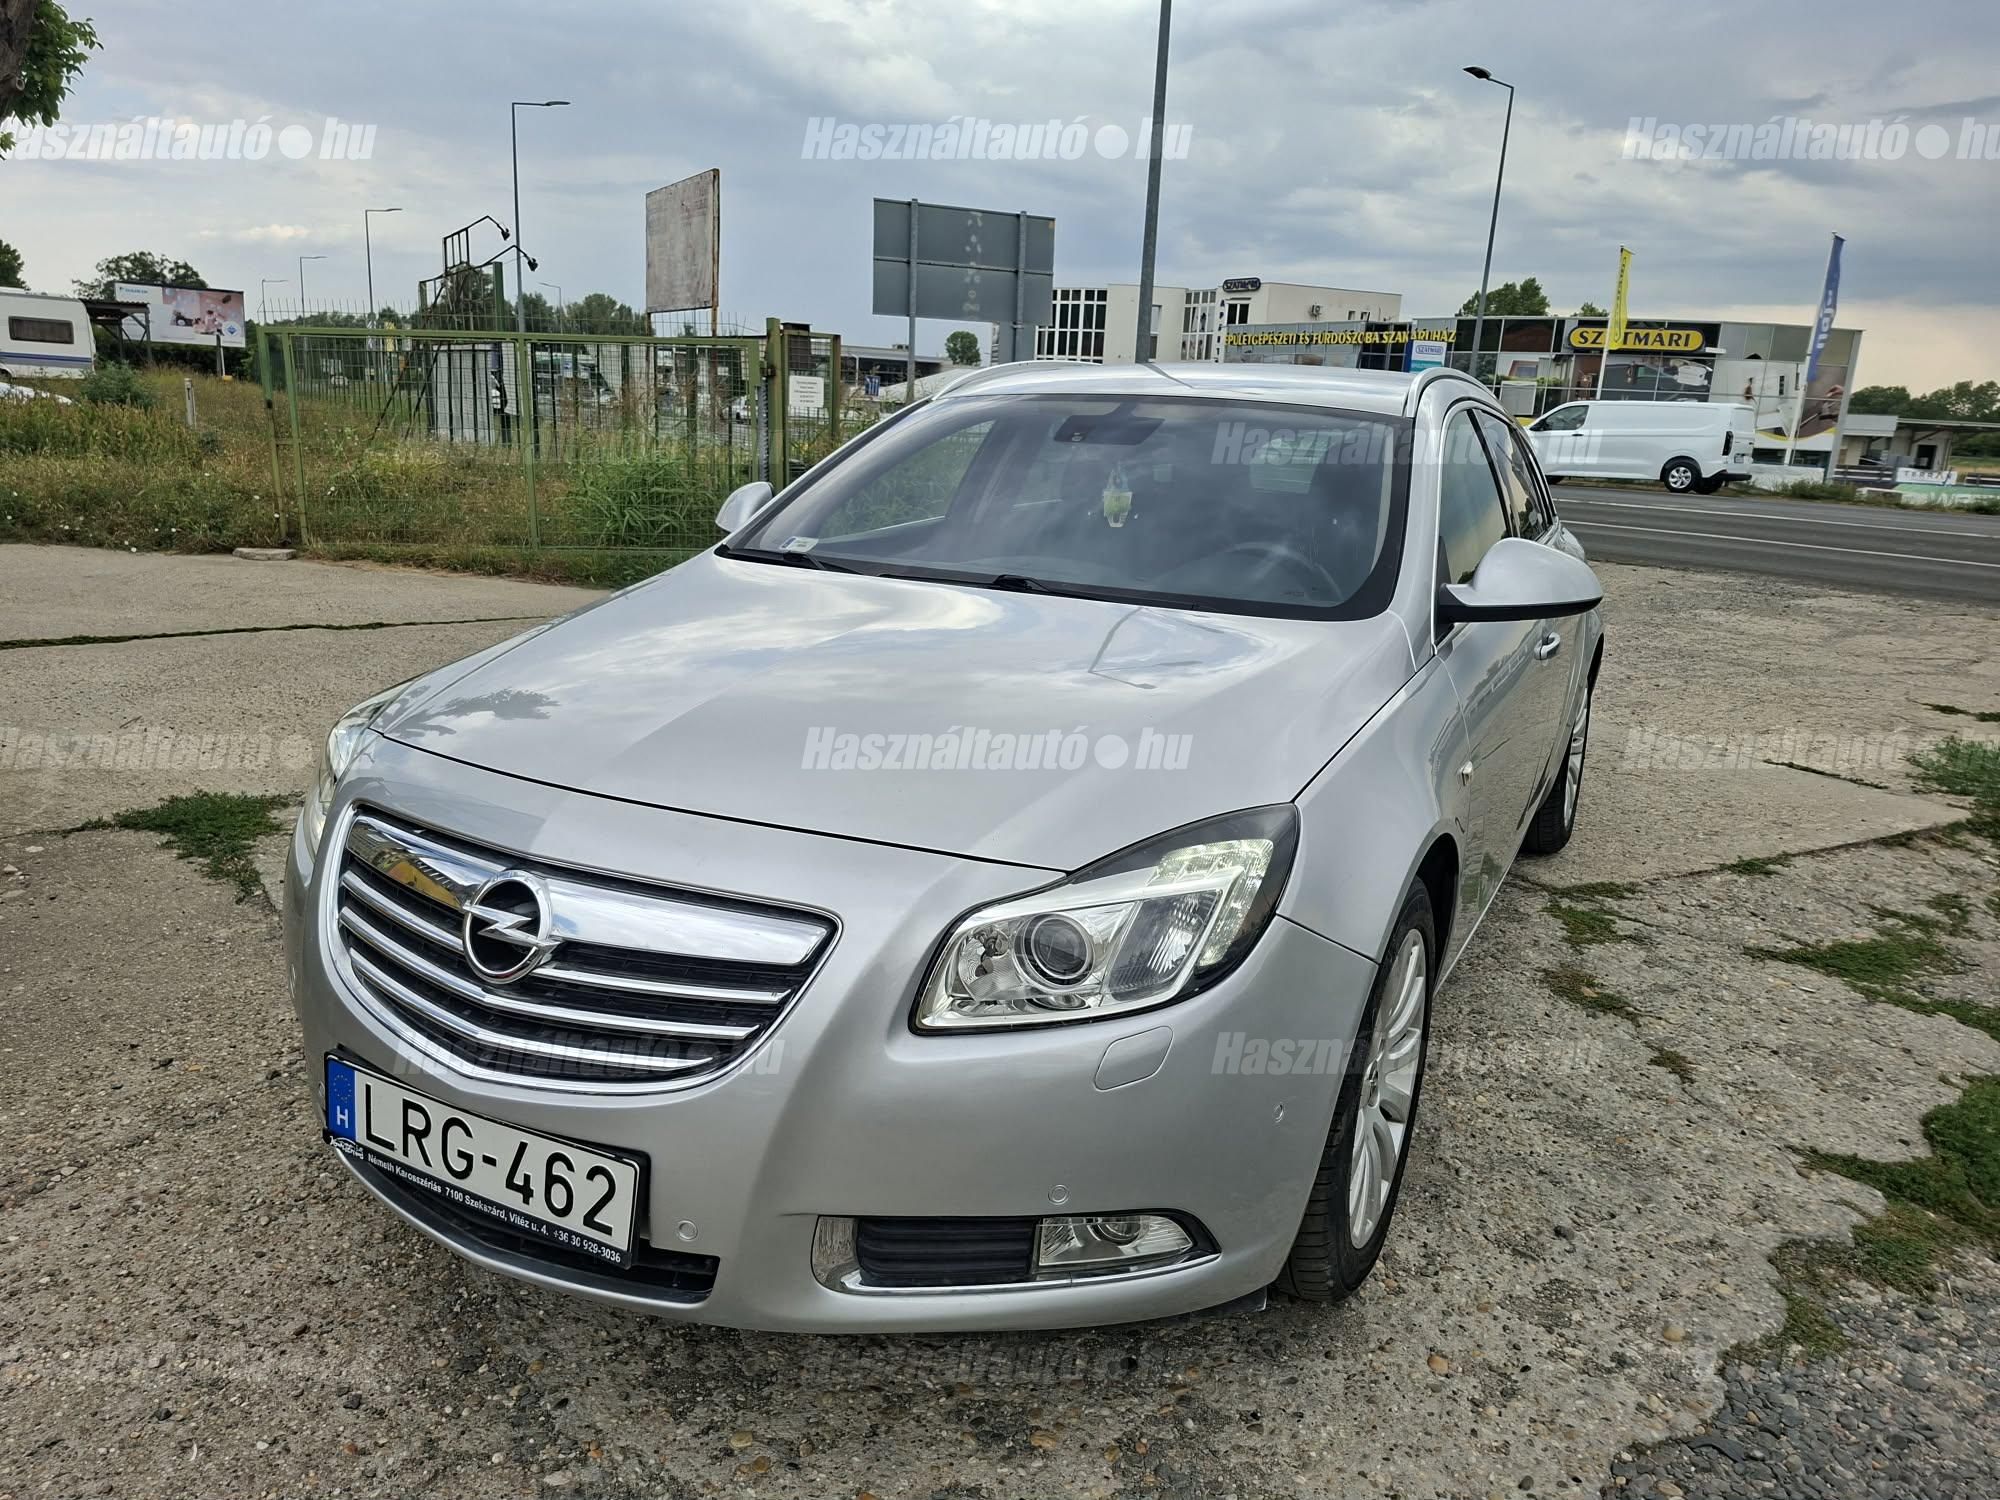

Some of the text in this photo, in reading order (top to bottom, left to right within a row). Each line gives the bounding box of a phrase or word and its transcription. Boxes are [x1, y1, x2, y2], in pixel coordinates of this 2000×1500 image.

[1578, 328, 1691, 348] SZTMÁRI
[335, 1104, 349, 1129] H
[364, 1082, 618, 1237] LRG-462
[367, 1153, 395, 1173] Németh
[395, 1165, 442, 1193] Karosszériás
[445, 1187, 463, 1202] 7100
[465, 1195, 508, 1221] Szekszárd,
[509, 1212, 530, 1229] Vitéz
[540, 1224, 549, 1236] 4.
[553, 1230, 569, 1243] +36
[571, 1234, 581, 1247] 30
[582, 1239, 621, 1263] 929-3036
